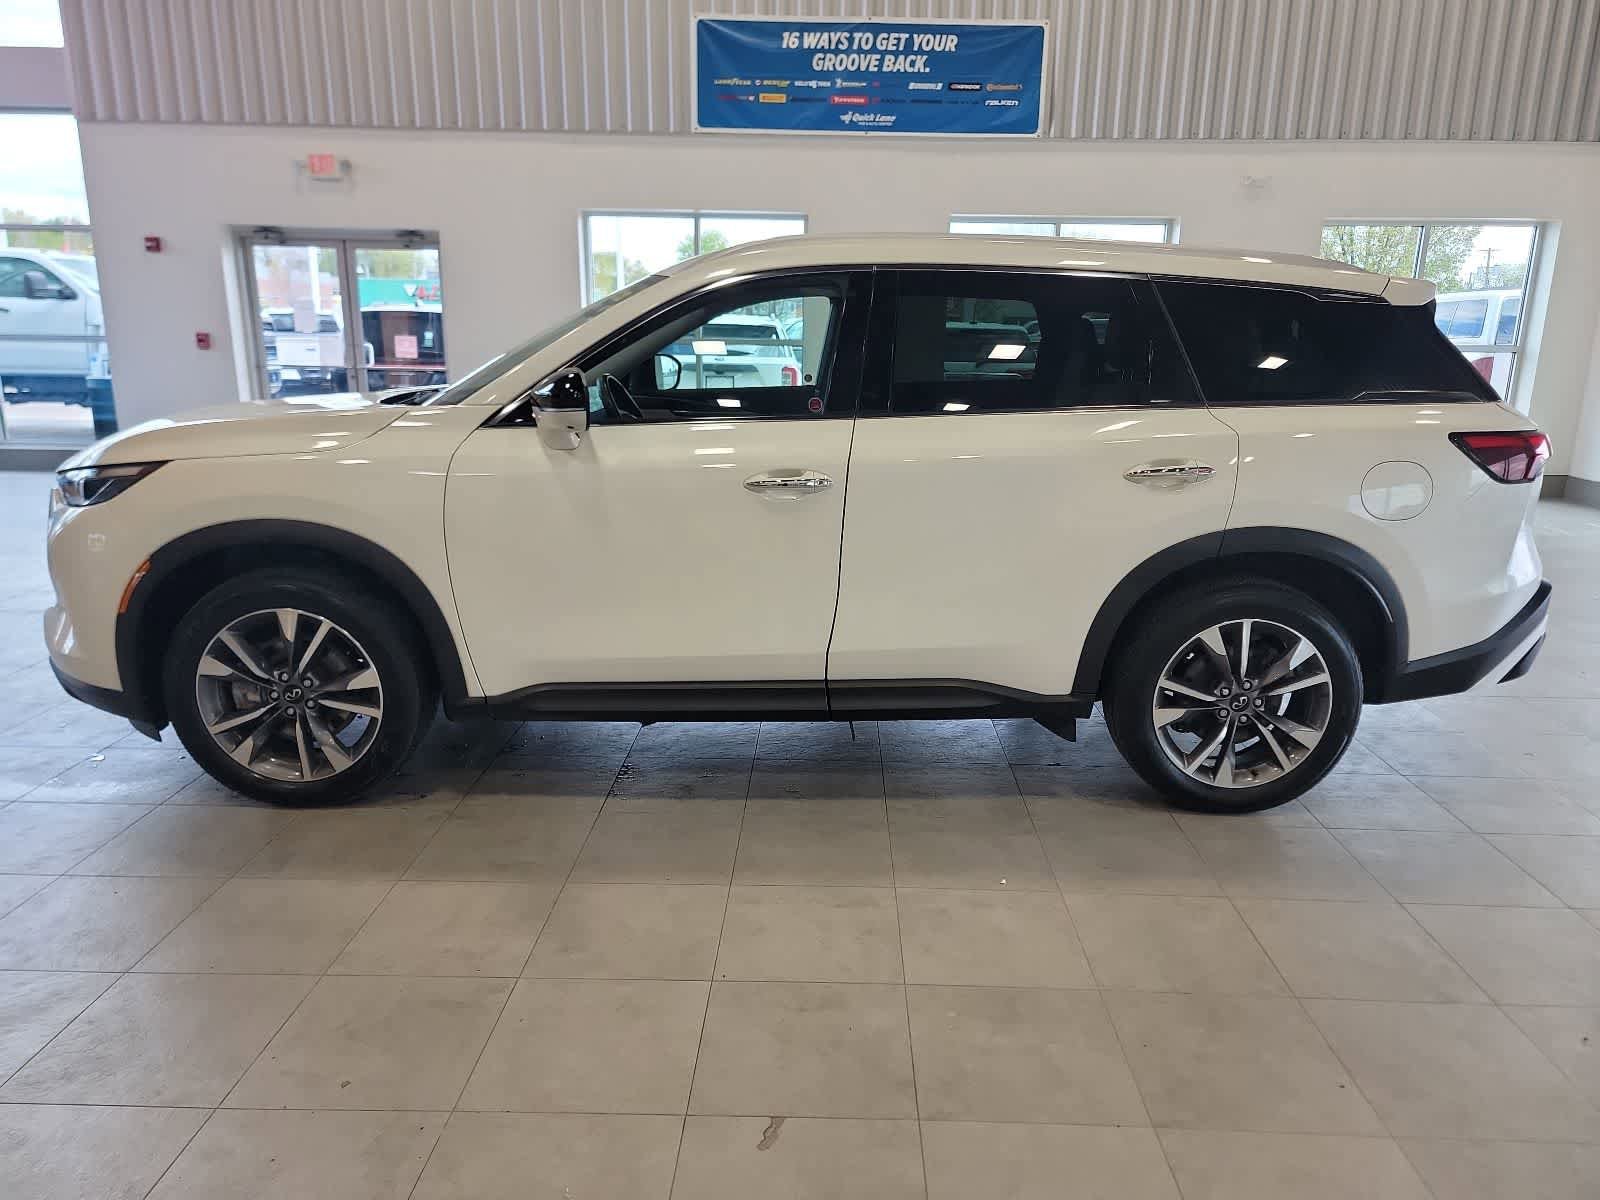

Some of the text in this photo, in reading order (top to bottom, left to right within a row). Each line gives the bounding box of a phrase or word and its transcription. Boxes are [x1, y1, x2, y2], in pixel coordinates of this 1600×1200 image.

[781, 31, 959, 52] 16 WAYS TO GET YOUR
[811, 53, 931, 73] GROOVE BACK.
[852, 112, 876, 122] Quick
